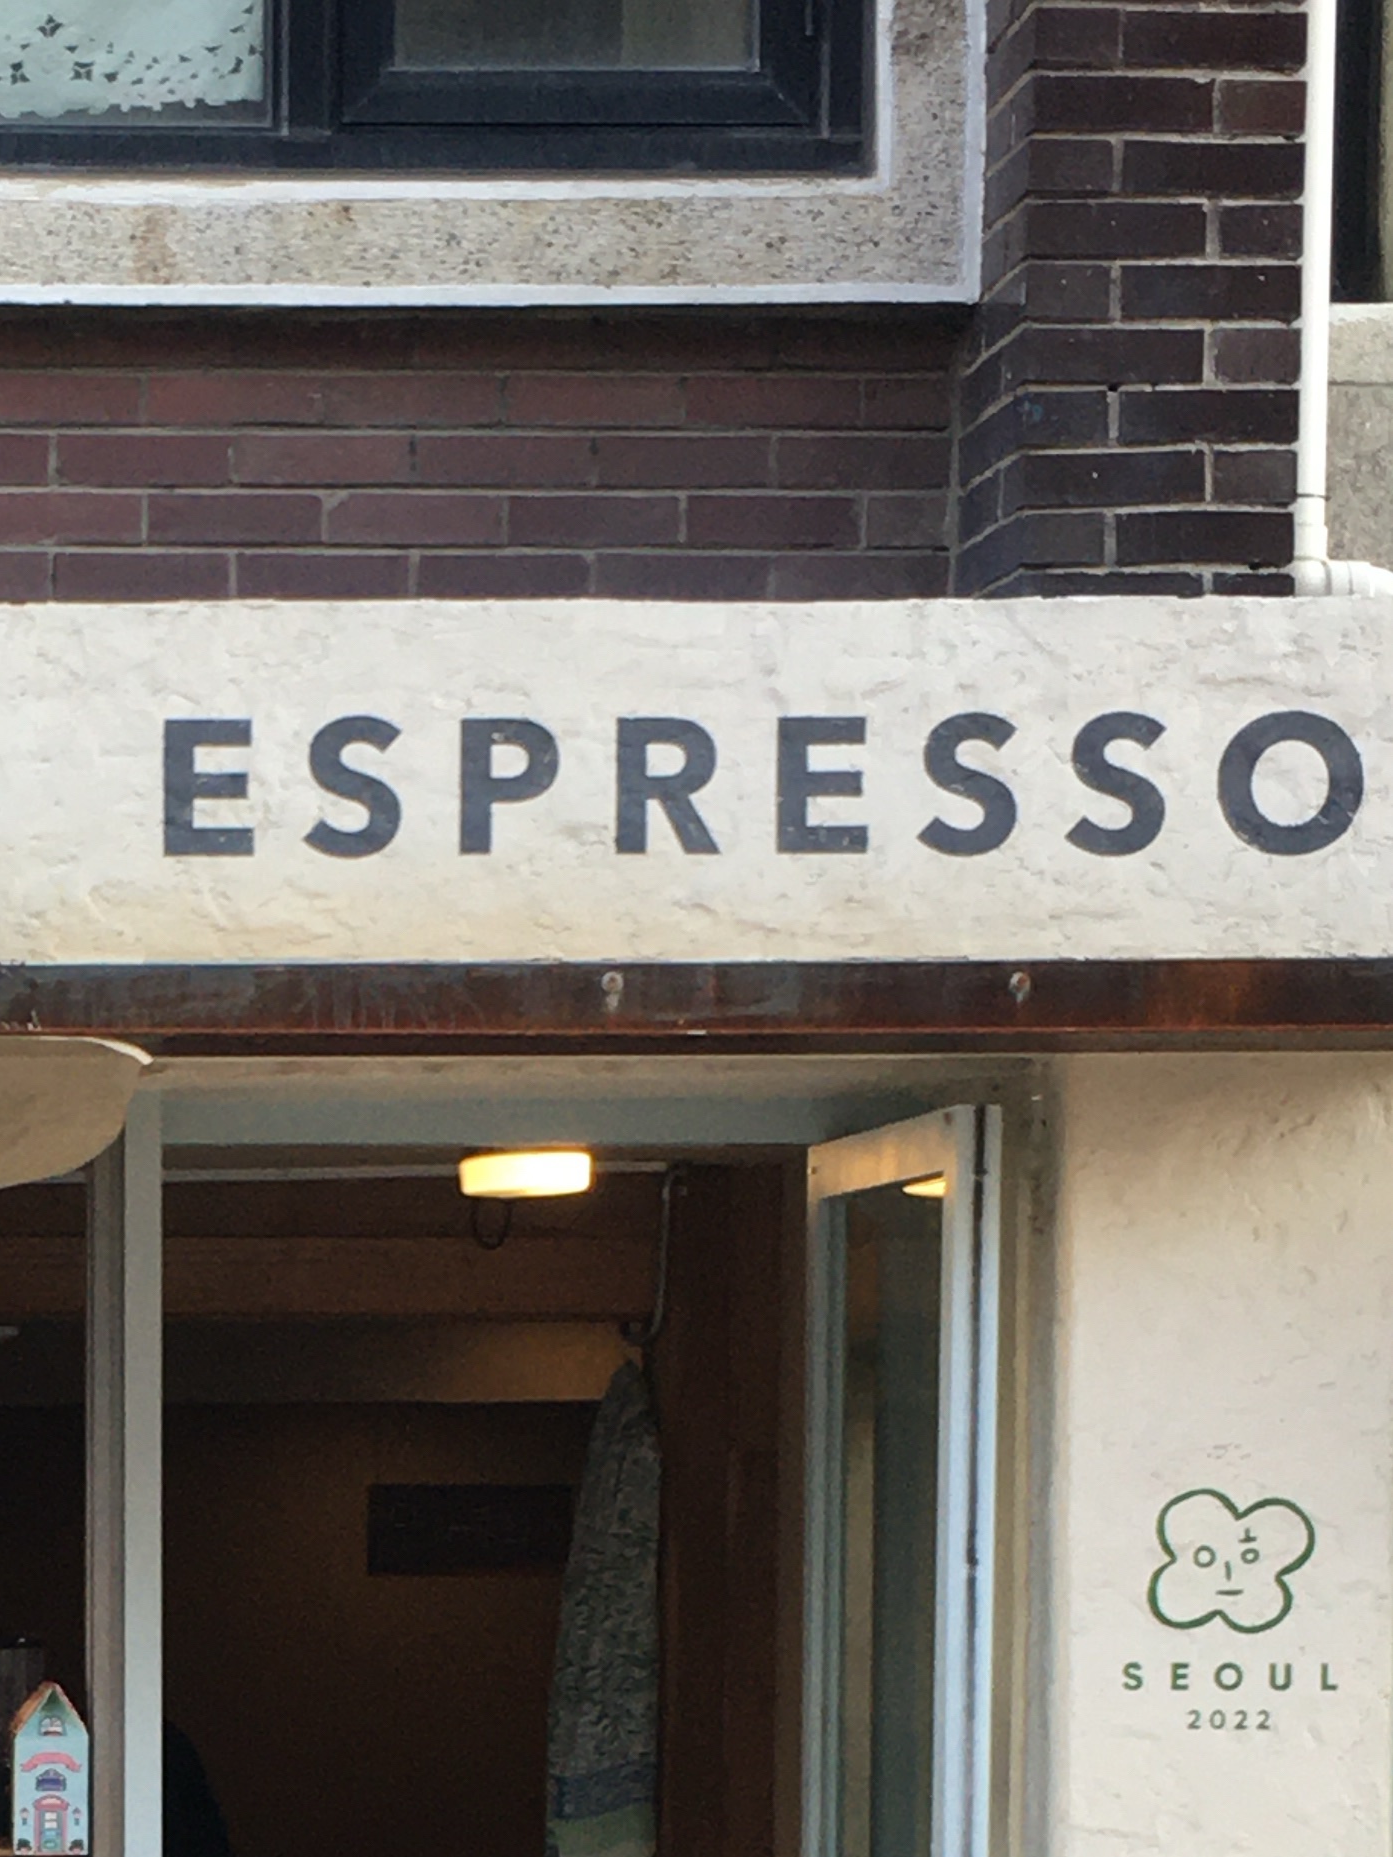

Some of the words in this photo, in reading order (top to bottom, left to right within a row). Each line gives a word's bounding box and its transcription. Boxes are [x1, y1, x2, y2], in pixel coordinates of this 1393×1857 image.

[162, 710, 1364, 857] ESPRESSO
[1122, 1662, 1338, 1690] SEOUL
[1187, 1709, 1271, 1730] 2022
